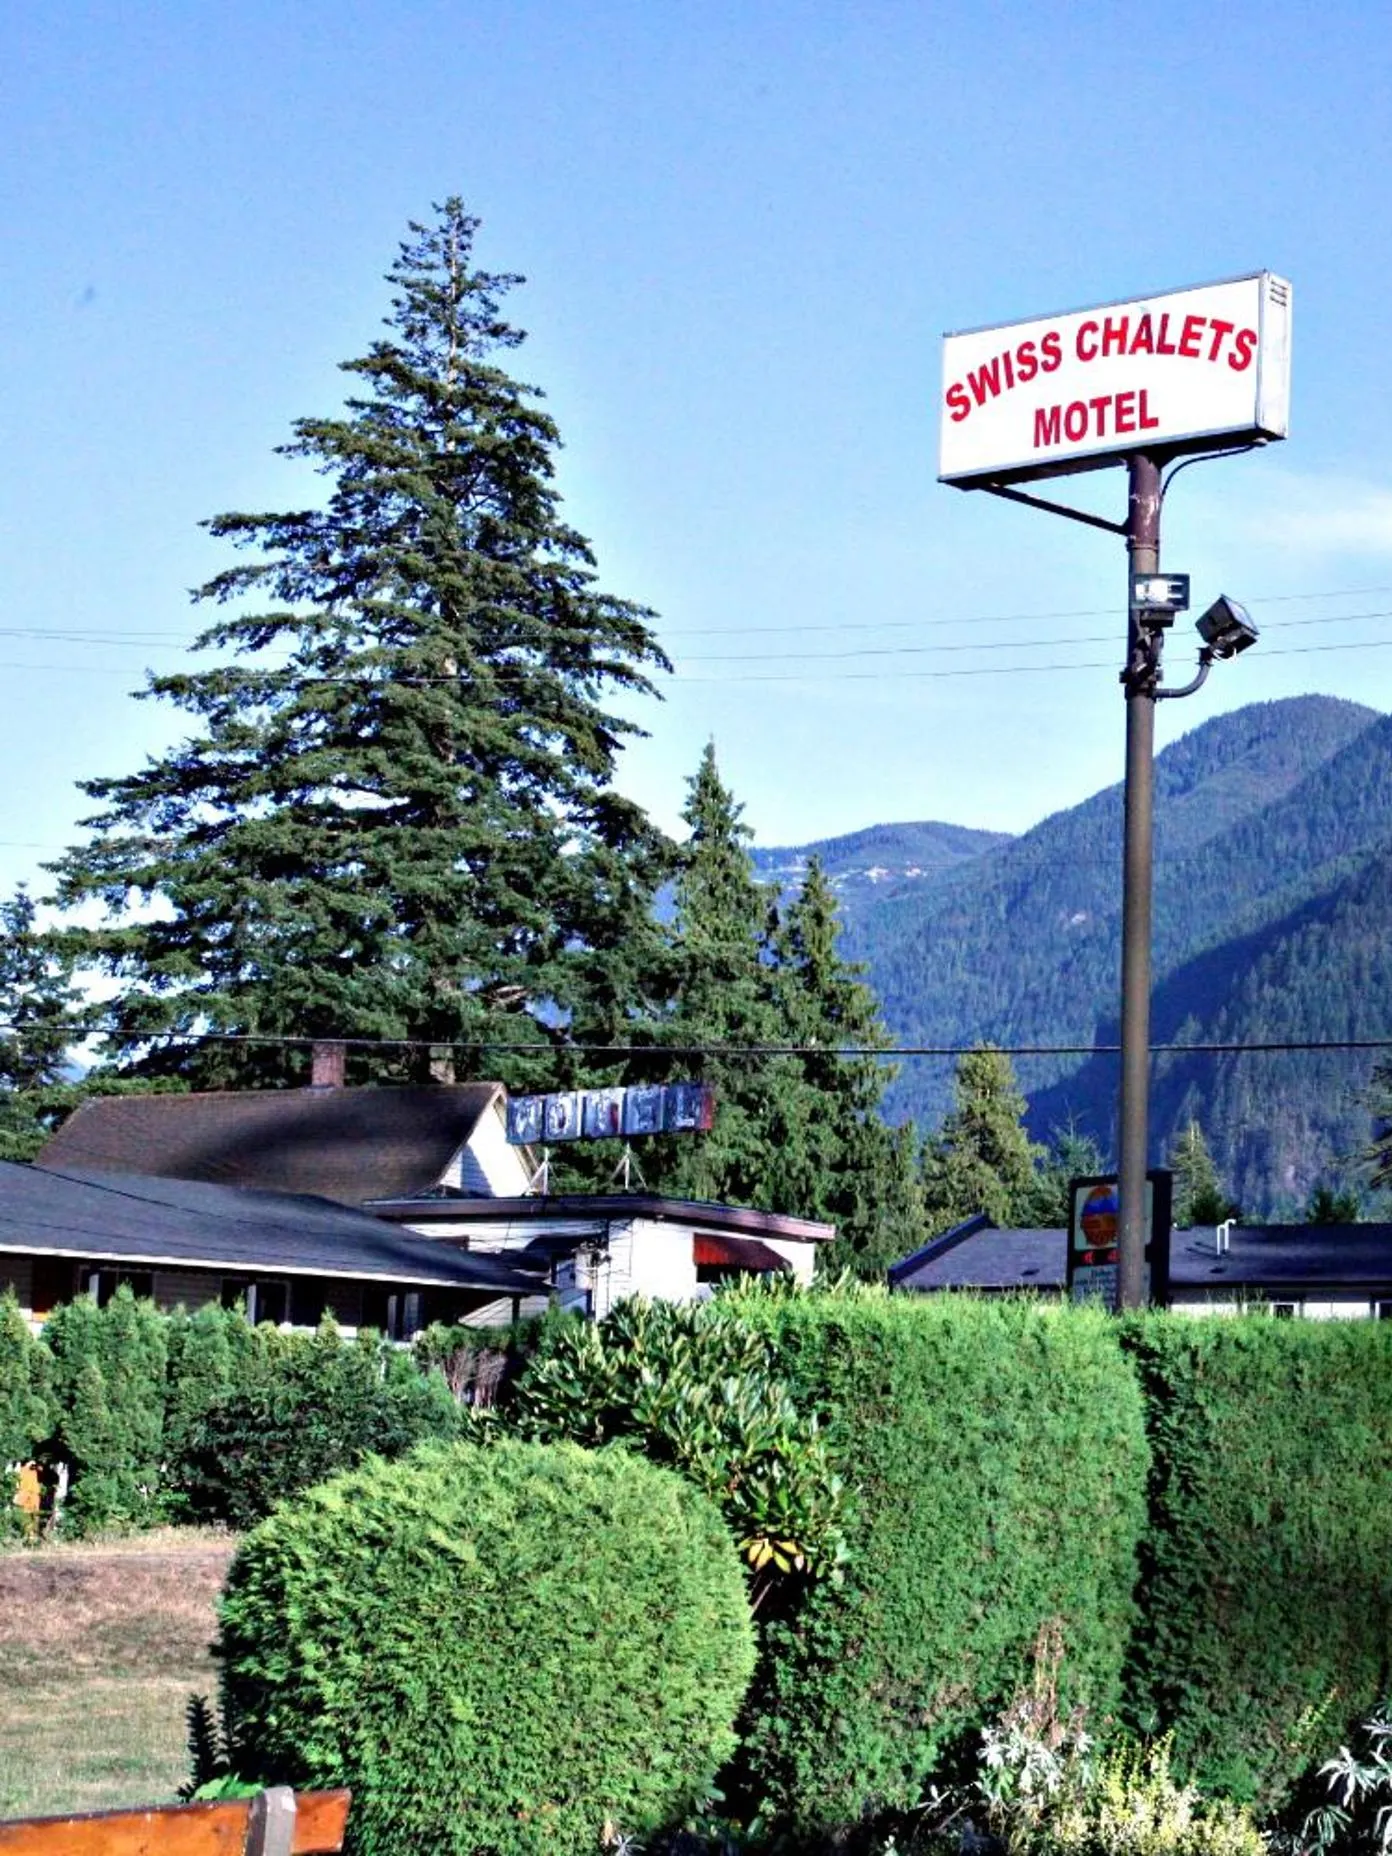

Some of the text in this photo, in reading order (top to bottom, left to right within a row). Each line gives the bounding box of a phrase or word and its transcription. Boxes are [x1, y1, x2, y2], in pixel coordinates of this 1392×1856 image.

[945, 313, 1257, 422] SWISS CHALETS
[1033, 389, 1159, 448] MOTEL
[511, 1087, 698, 1138] MOTEL
